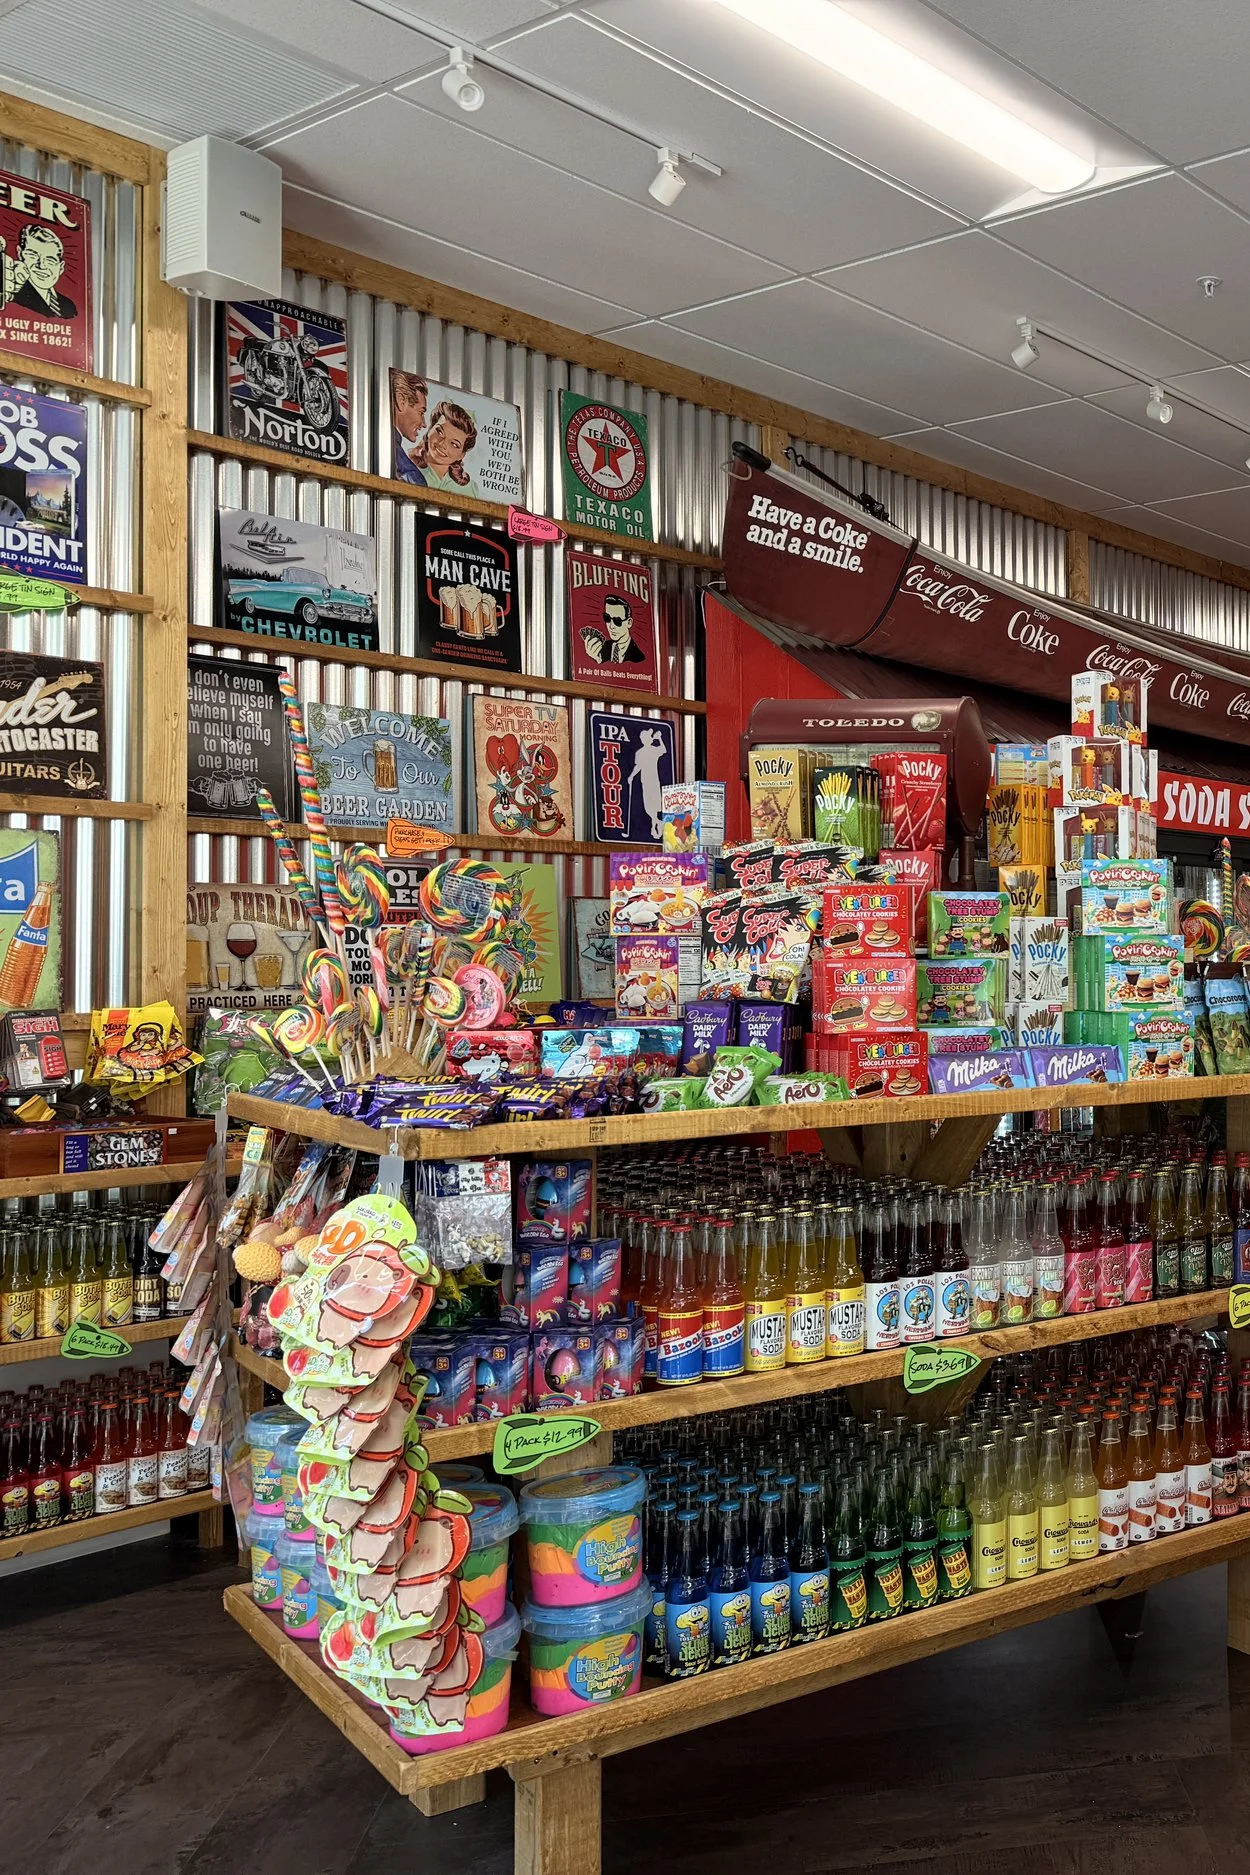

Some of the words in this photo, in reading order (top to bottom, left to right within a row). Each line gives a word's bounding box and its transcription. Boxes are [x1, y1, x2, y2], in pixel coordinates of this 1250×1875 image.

[5, 318, 30, 331] UGLY
[33, 321, 72, 336] PEOPLE
[10, 330, 39, 344] SINCE
[42, 333, 72, 348] 1862!
[232, 399, 347, 460] Norton
[492, 416, 502, 426] IF
[480, 425, 519, 442] AGREED
[587, 427, 627, 448] TEXACO
[487, 437, 513, 451] WITH
[490, 447, 513, 463] YOU,
[487, 459, 512, 473] WE'D
[479, 467, 507, 484] BOTH
[508, 474, 520, 487] BE
[482, 479, 519, 497] WRONG
[573, 494, 645, 524] TEXACO
[575, 511, 617, 531] MOTOR
[626, 525, 646, 539] OIL
[747, 494, 803, 531] Have
[803, 515, 816, 535] a
[818, 515, 869, 550] Coke
[440, 547, 453, 557] SOME
[453, 549, 466, 559] CALL
[465, 552, 476, 561] THIS
[475, 553, 490, 564] PLACE
[746, 523, 786, 551] and
[787, 536, 801, 556] a
[802, 540, 865, 574] smile.
[20, 554, 51, 569] HAPPY
[53, 561, 84, 574] AGAIN
[424, 554, 464, 584] MAN
[469, 563, 512, 593] CAVE
[571, 559, 649, 604] BLUFFING
[230, 612, 241, 623] by
[240, 615, 373, 651] CHEVROLET
[1006, 609, 1060, 656] Coke
[194, 669, 230, 689] don't
[232, 677, 264, 693] even
[583, 667, 593, 676] Pair
[600, 669, 612, 678] Balls
[612, 670, 626, 680] Beats
[626, 672, 653, 682] Everything!
[187, 686, 227, 705] elieve
[229, 692, 274, 712] myself
[1169, 672, 1211, 710] Coke
[190, 702, 229, 722] when
[238, 709, 263, 728] say
[484, 703, 533, 720] SUPER
[534, 706, 558, 721] TV
[485, 716, 560, 736] SATURDAY
[598, 723, 631, 743] IPA
[802, 718, 905, 728] TOLEDO
[204, 721, 233, 740] only
[235, 724, 271, 747] going
[319, 715, 443, 763] WELCOME
[519, 733, 558, 744] MORNING
[203, 736, 215, 752] to
[220, 738, 252, 756] have
[198, 753, 222, 770] one
[225, 755, 260, 773] beer!
[330, 754, 361, 781] To
[402, 762, 441, 786] Our
[600, 741, 625, 829] TOUR
[319, 793, 371, 818] BEER
[375, 797, 448, 823] GARDEN
[1163, 780, 1231, 829] SODA
[944, 899, 1000, 908] CHOCOLATEY
[958, 916, 987, 924] COOKIES
[18, 924, 47, 942] Fanta
[189, 995, 257, 1010] PRACTICED
[263, 994, 292, 1007] HERE
[739, 1008, 783, 1026] Cadbury
[13, 1020, 59, 1035] SIGH
[748, 1029, 769, 1038] MILK
[946, 1055, 1001, 1087] Milka
[109, 1136, 145, 1151] GEM
[95, 1149, 158, 1167] STONES
[133, 1278, 158, 1291] DIRT
[841, 1329, 861, 1340] SODA
[910, 1361, 934, 1374] SODA
[935, 1358, 966, 1374] $3.69
[505, 1440, 512, 1452] 4
[543, 1427, 584, 1446] $12.99
[585, 1536, 626, 1558] High
[585, 1545, 639, 1568] Bouncing
